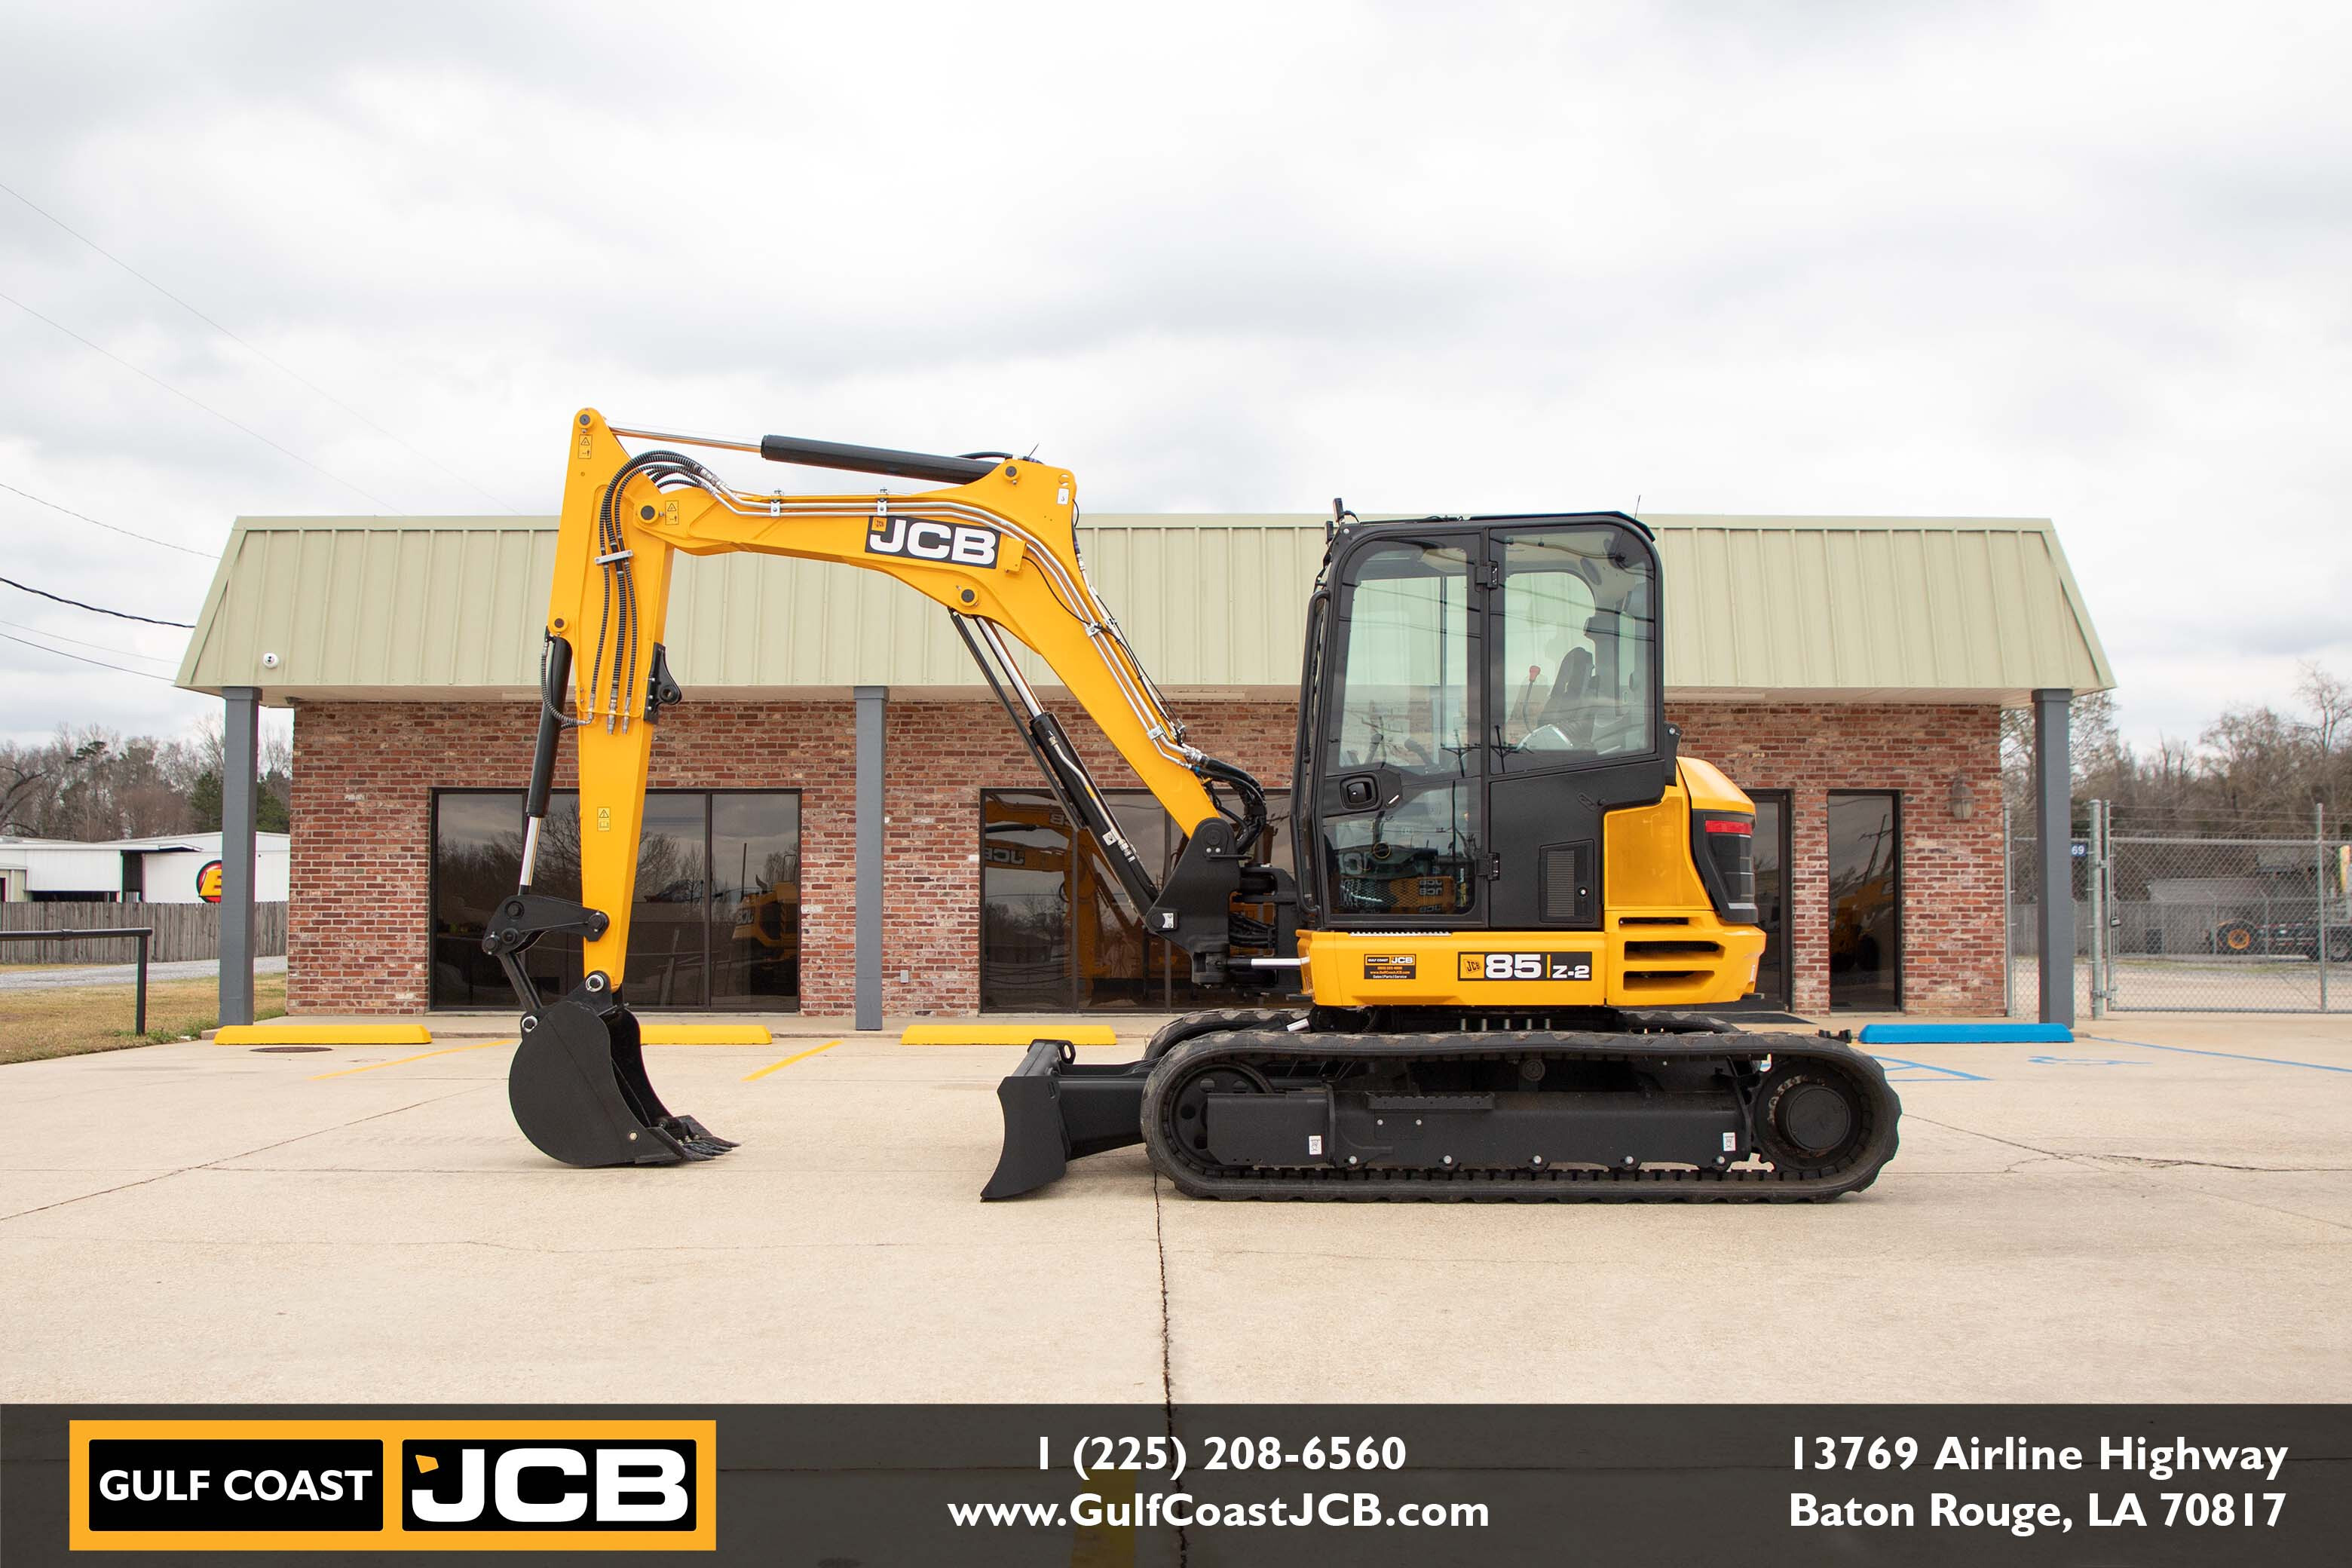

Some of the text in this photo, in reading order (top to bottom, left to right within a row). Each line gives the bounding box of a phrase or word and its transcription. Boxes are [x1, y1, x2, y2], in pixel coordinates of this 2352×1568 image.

[869, 519, 997, 565] JCB
[1466, 960, 1481, 972] JCB
[1485, 954, 1590, 978] 85 Z-2
